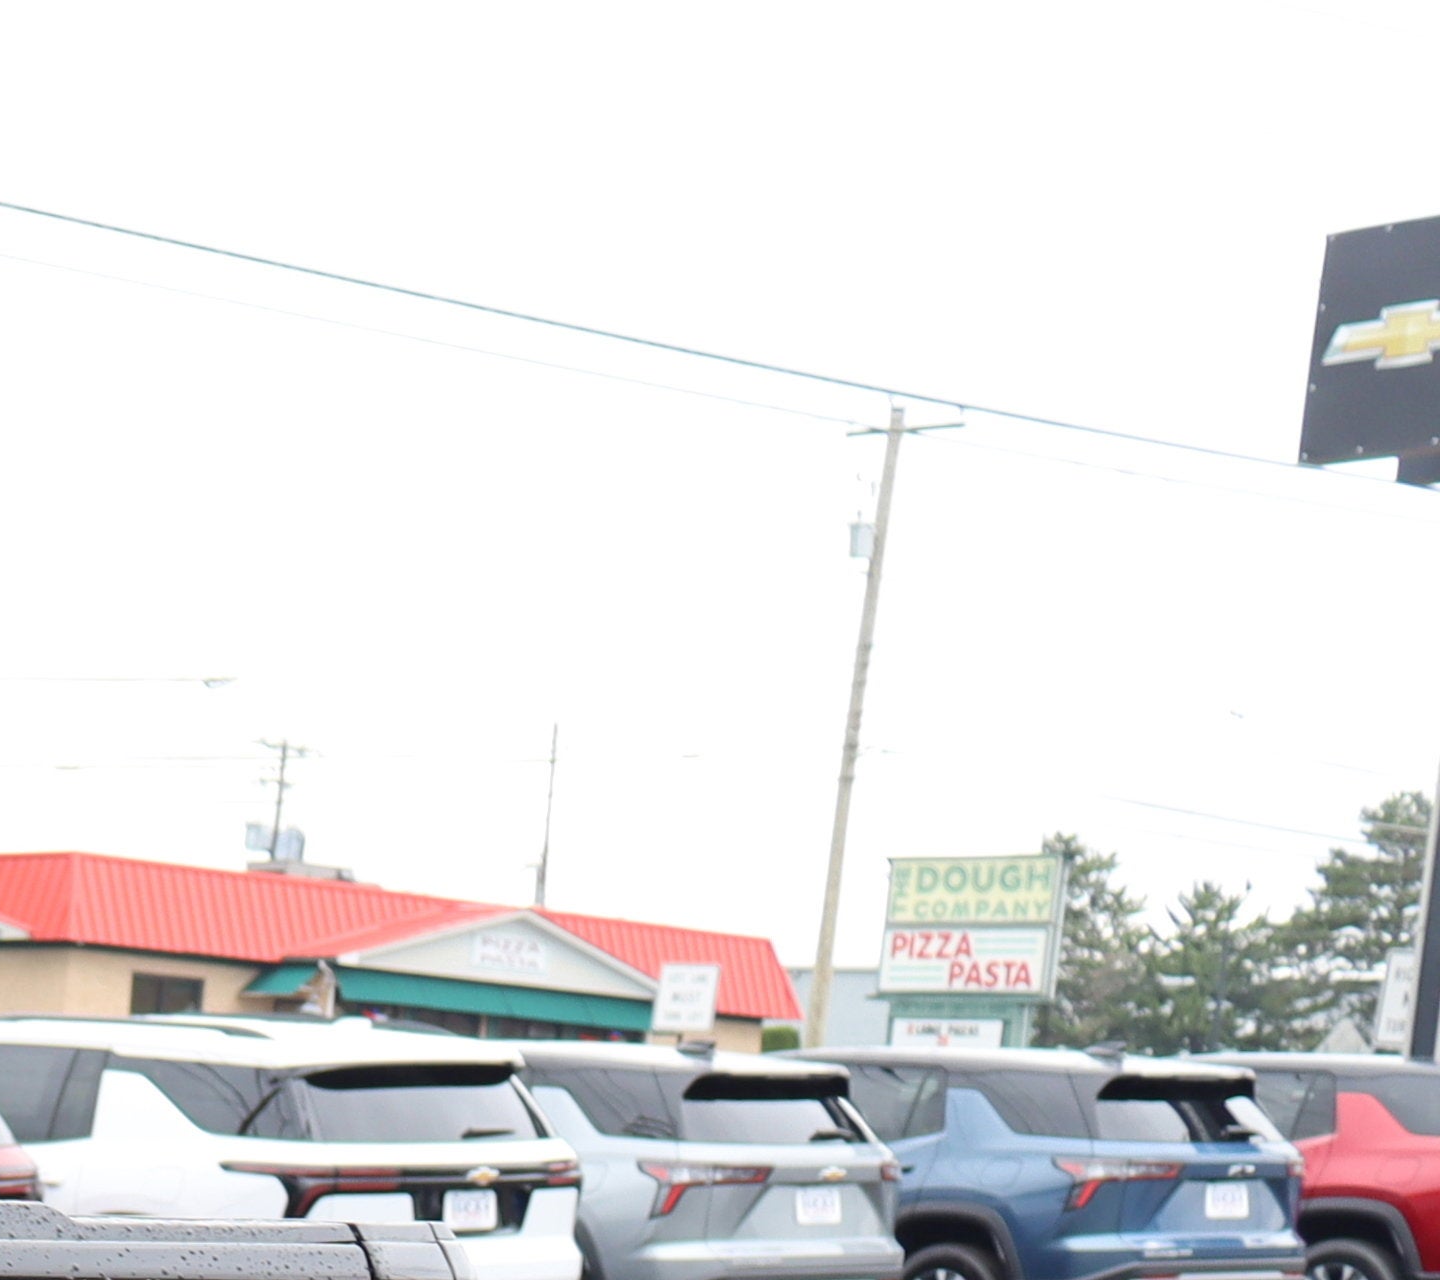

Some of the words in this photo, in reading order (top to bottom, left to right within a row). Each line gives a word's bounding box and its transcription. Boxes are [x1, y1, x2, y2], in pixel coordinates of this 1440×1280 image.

[916, 864, 1051, 893] DOUGH
[913, 900, 1050, 918] COMPANY
[892, 931, 971, 959] PIZZA
[948, 962, 1032, 988] PASTA
